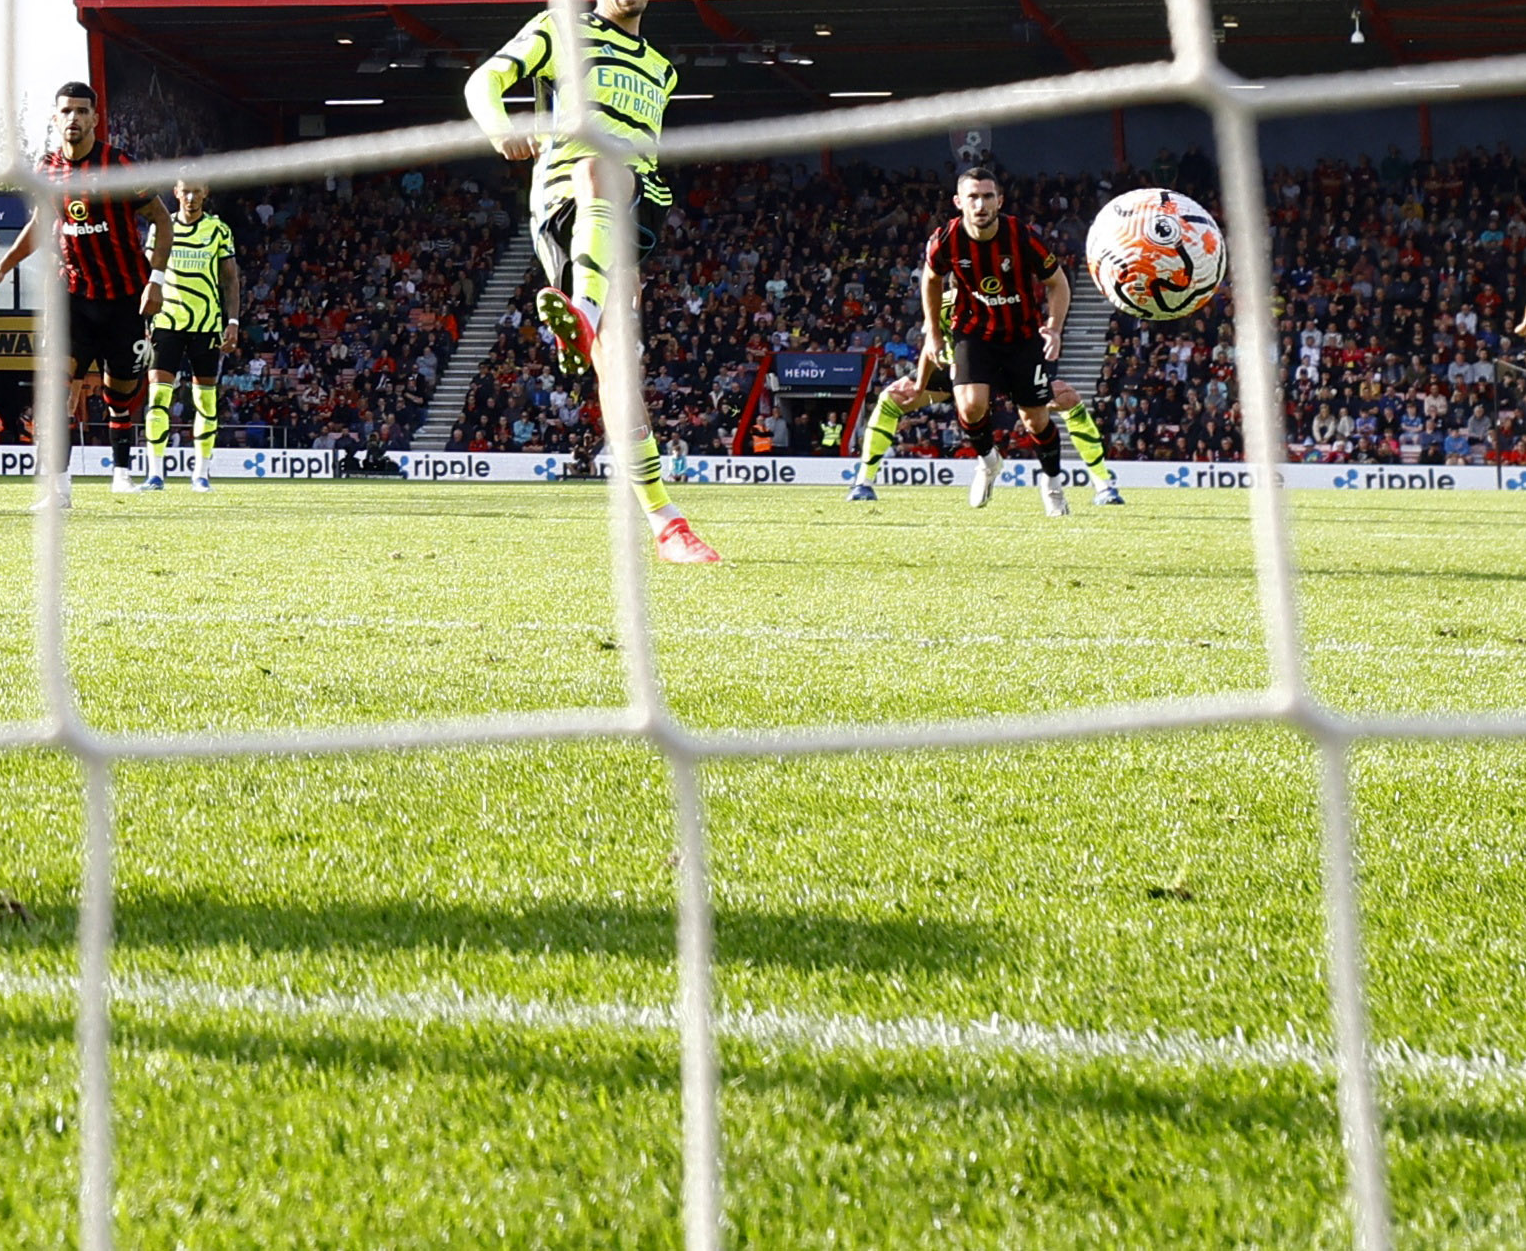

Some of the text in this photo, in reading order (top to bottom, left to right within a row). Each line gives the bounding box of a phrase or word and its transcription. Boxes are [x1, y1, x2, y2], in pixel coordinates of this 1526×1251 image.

[597, 67, 666, 109] Emirate
[612, 91, 630, 108] FLY
[171, 250, 212, 260] mirates
[784, 368, 826, 379] HENDY
[1033, 363, 1048, 388] 4
[270, 453, 336, 478] rippl
[414, 454, 491, 480] ripple
[714, 459, 796, 484] ripple
[1364, 467, 1456, 490] ripple
